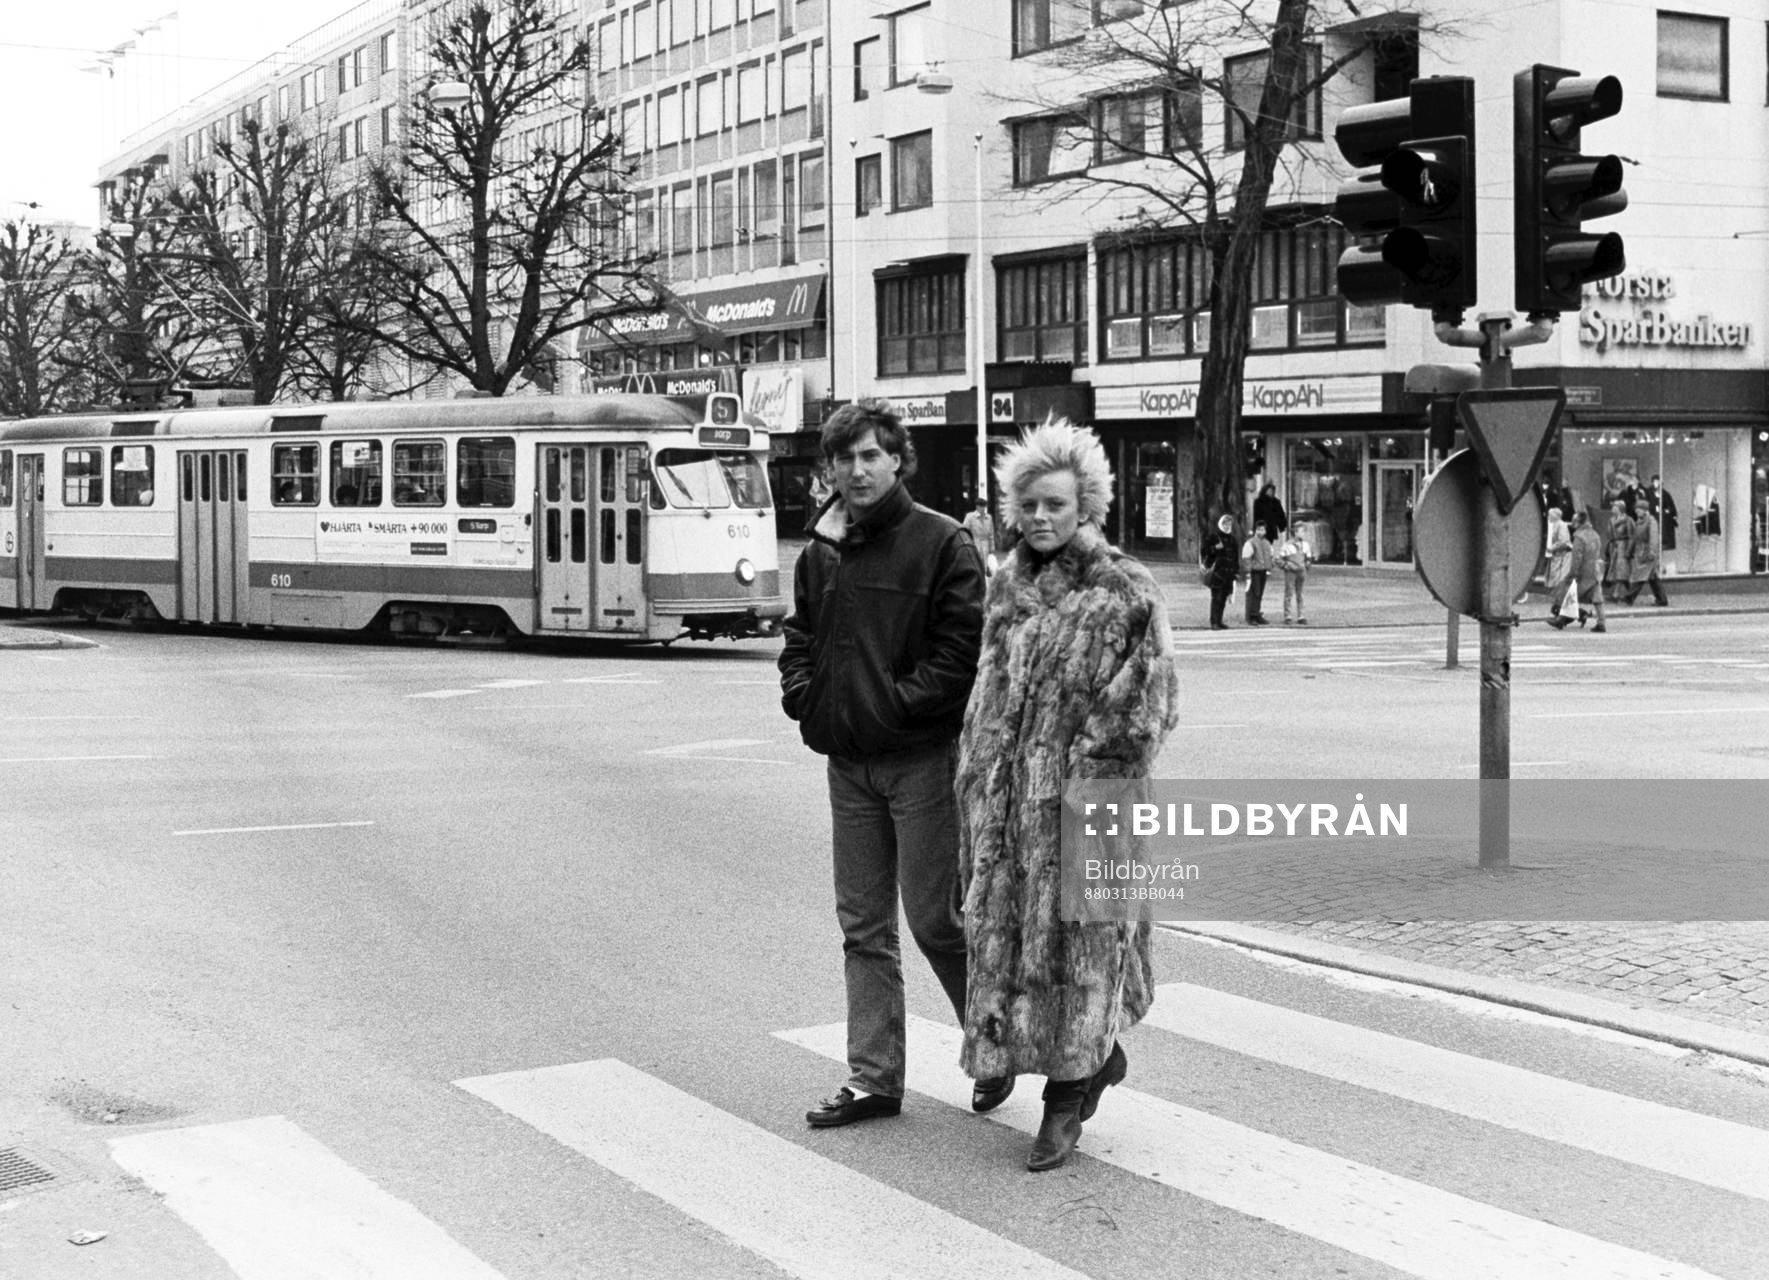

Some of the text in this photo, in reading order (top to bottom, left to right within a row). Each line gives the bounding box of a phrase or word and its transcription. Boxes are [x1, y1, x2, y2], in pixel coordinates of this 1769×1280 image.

[706, 297, 775, 323] McDonald's
[1581, 308, 1755, 353] SparBanken
[667, 379, 716, 396] McDonald's
[994, 398, 1012, 416] 34
[1140, 388, 1199, 416] KappAh
[727, 524, 751, 539] 610
[271, 574, 291, 588] 610
